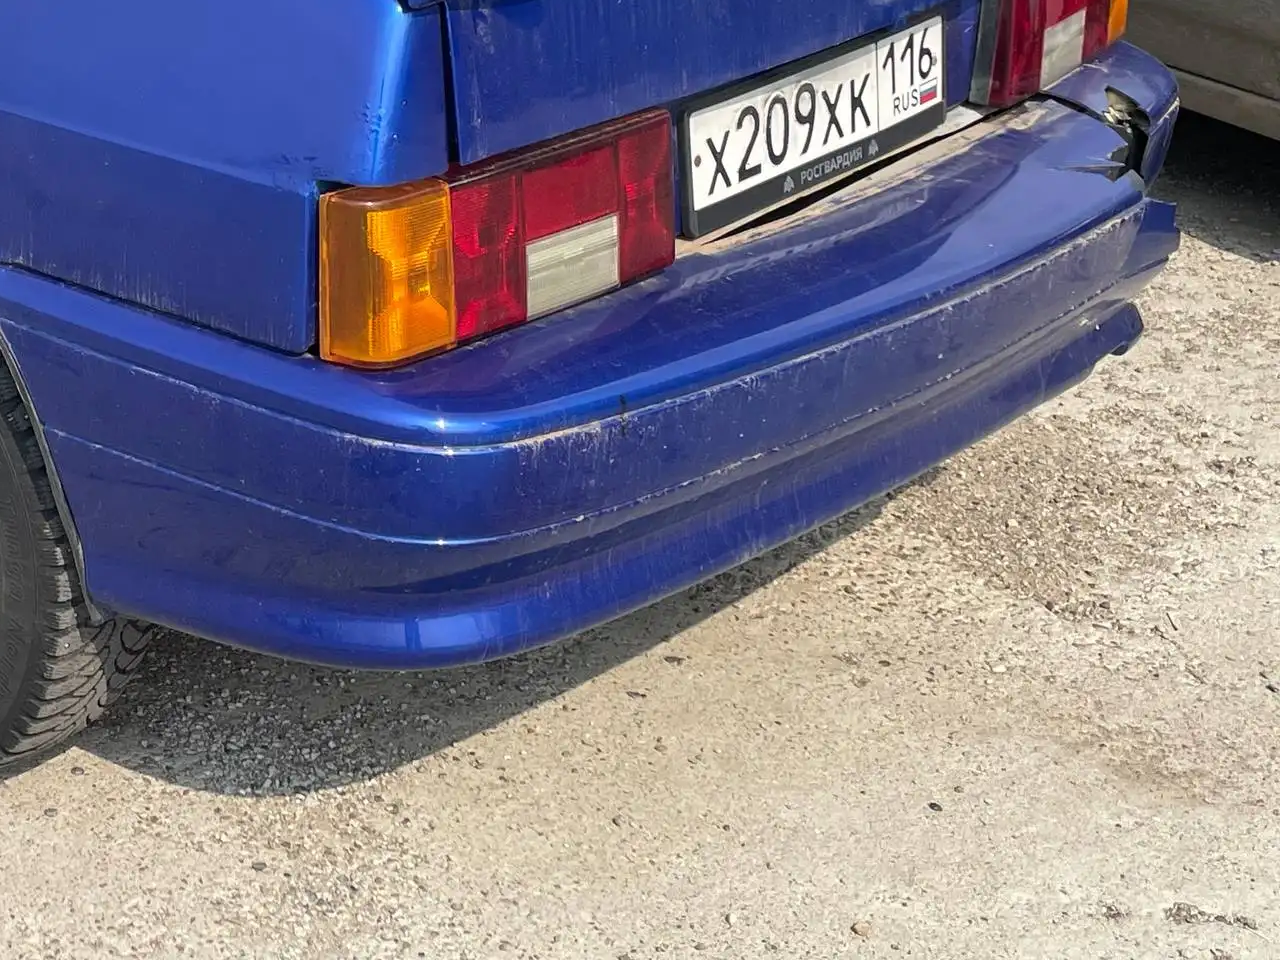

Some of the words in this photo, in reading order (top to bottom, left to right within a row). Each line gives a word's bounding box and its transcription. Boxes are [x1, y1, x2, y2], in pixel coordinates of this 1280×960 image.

[882, 27, 934, 95] 116
[892, 88, 919, 116] RUS
[800, 146, 864, 186] РОСГВАРДИЯ
